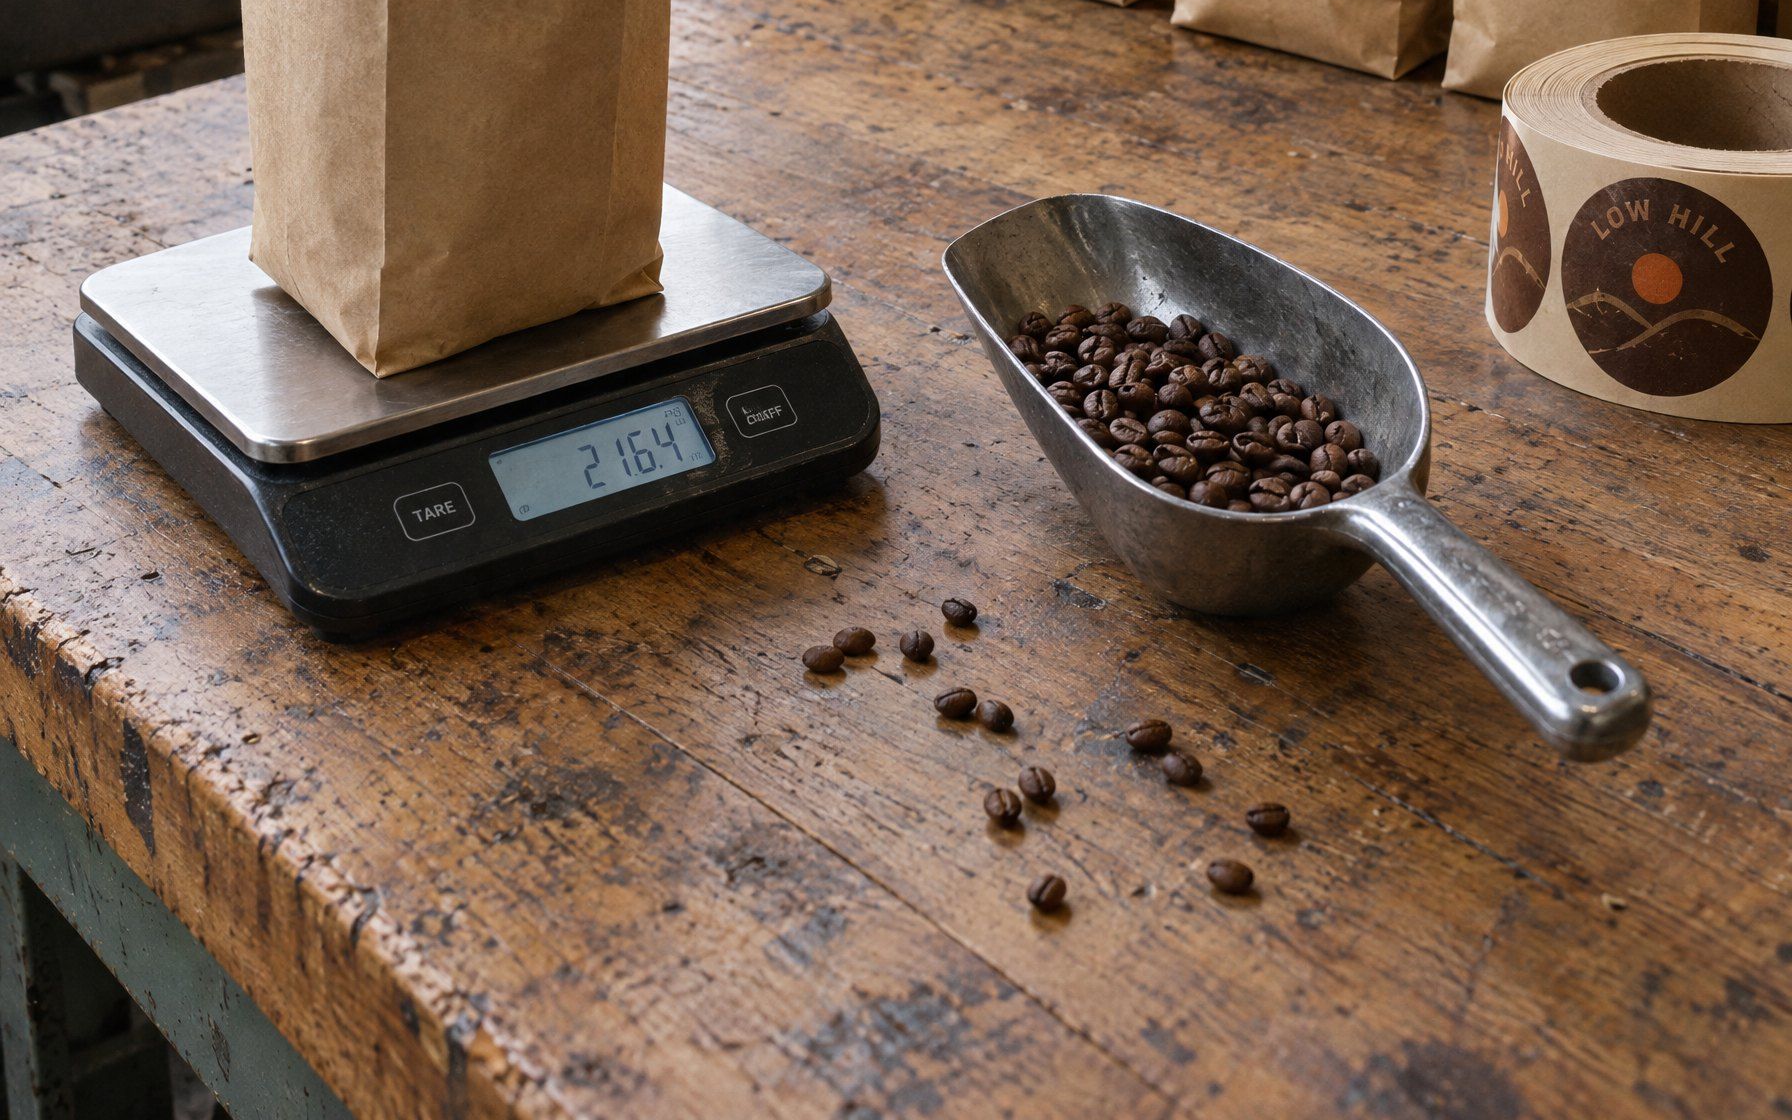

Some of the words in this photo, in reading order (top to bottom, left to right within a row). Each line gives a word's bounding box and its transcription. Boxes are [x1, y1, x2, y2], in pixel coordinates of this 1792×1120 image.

[1506, 143, 1531, 208] HILL
[1590, 198, 1651, 241] LOW
[1667, 203, 1737, 264] HILL
[411, 500, 457, 524] TARE
